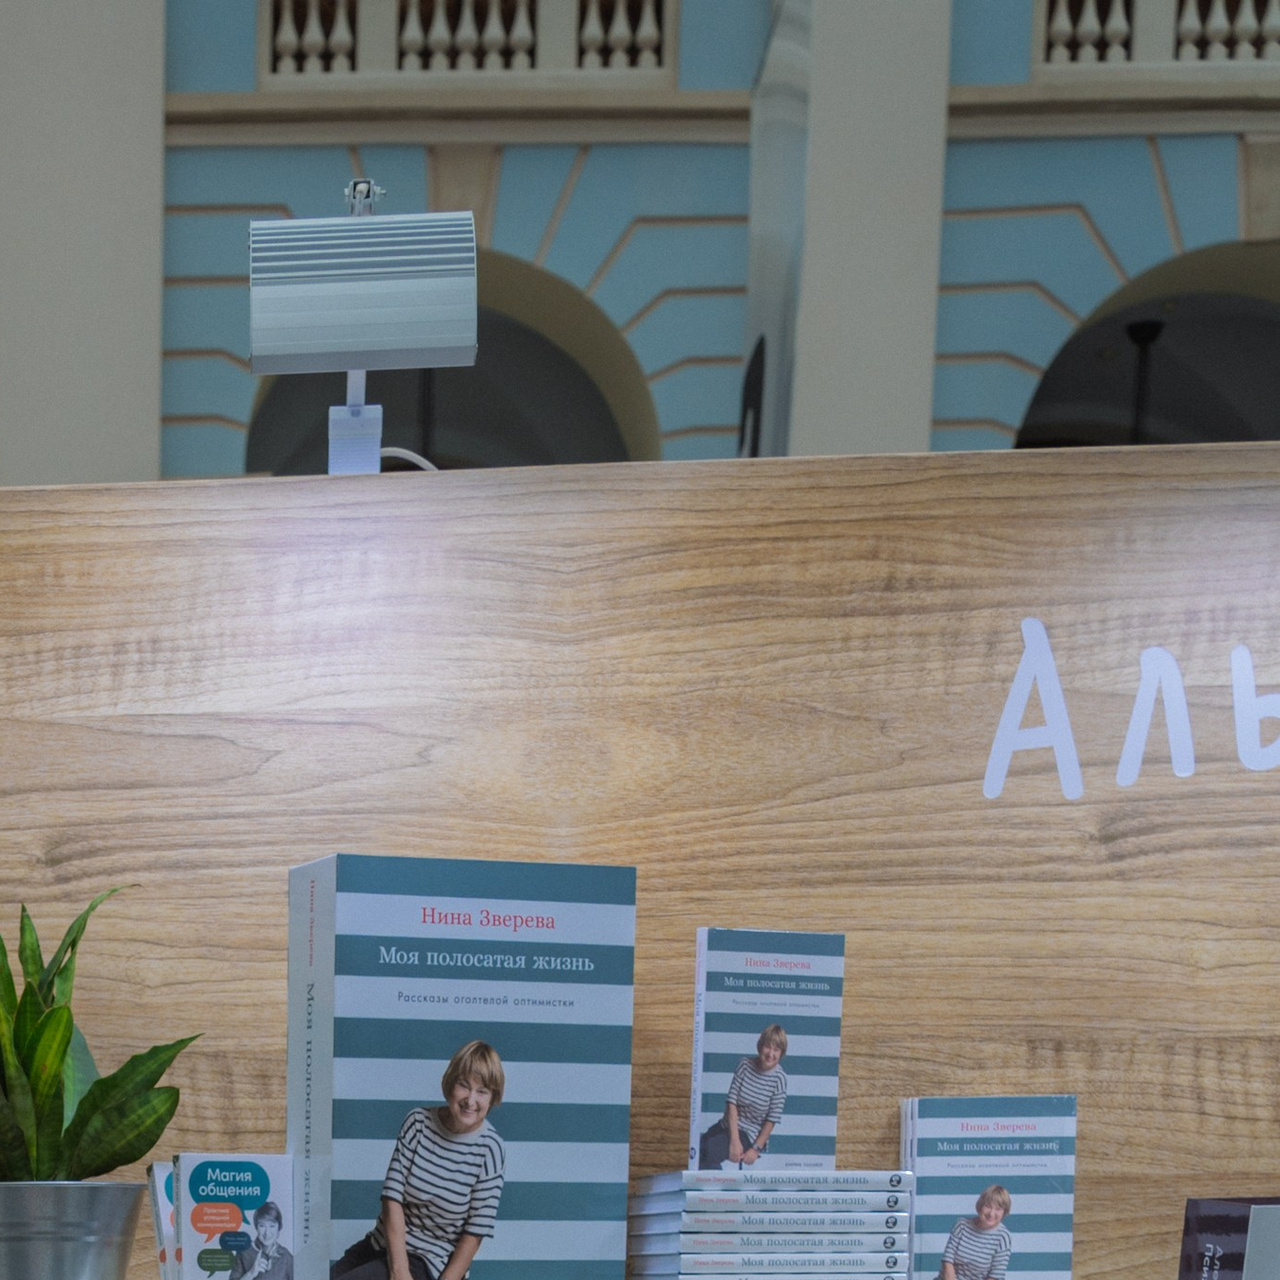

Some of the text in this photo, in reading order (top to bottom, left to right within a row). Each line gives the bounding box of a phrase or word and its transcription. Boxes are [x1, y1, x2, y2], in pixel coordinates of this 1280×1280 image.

[421, 907, 555, 932] Нина Зверева
[379, 946, 595, 971] Моя полосатая жизнь
[745, 958, 811, 970] Нина Зверева
[724, 977, 830, 990] Моя полосатая жизнь
[398, 991, 574, 1008] Рассказы оголтелой оптимистки
[961, 1122, 1036, 1133] Нина Зверева
[937, 1142, 959, 1151] Моя
[964, 1142, 1019, 1152] полосатая
[207, 1168, 252, 1182] Магия
[199, 1183, 260, 1198] общения
[741, 1257, 865, 1268] Моя полосатая жизнь
